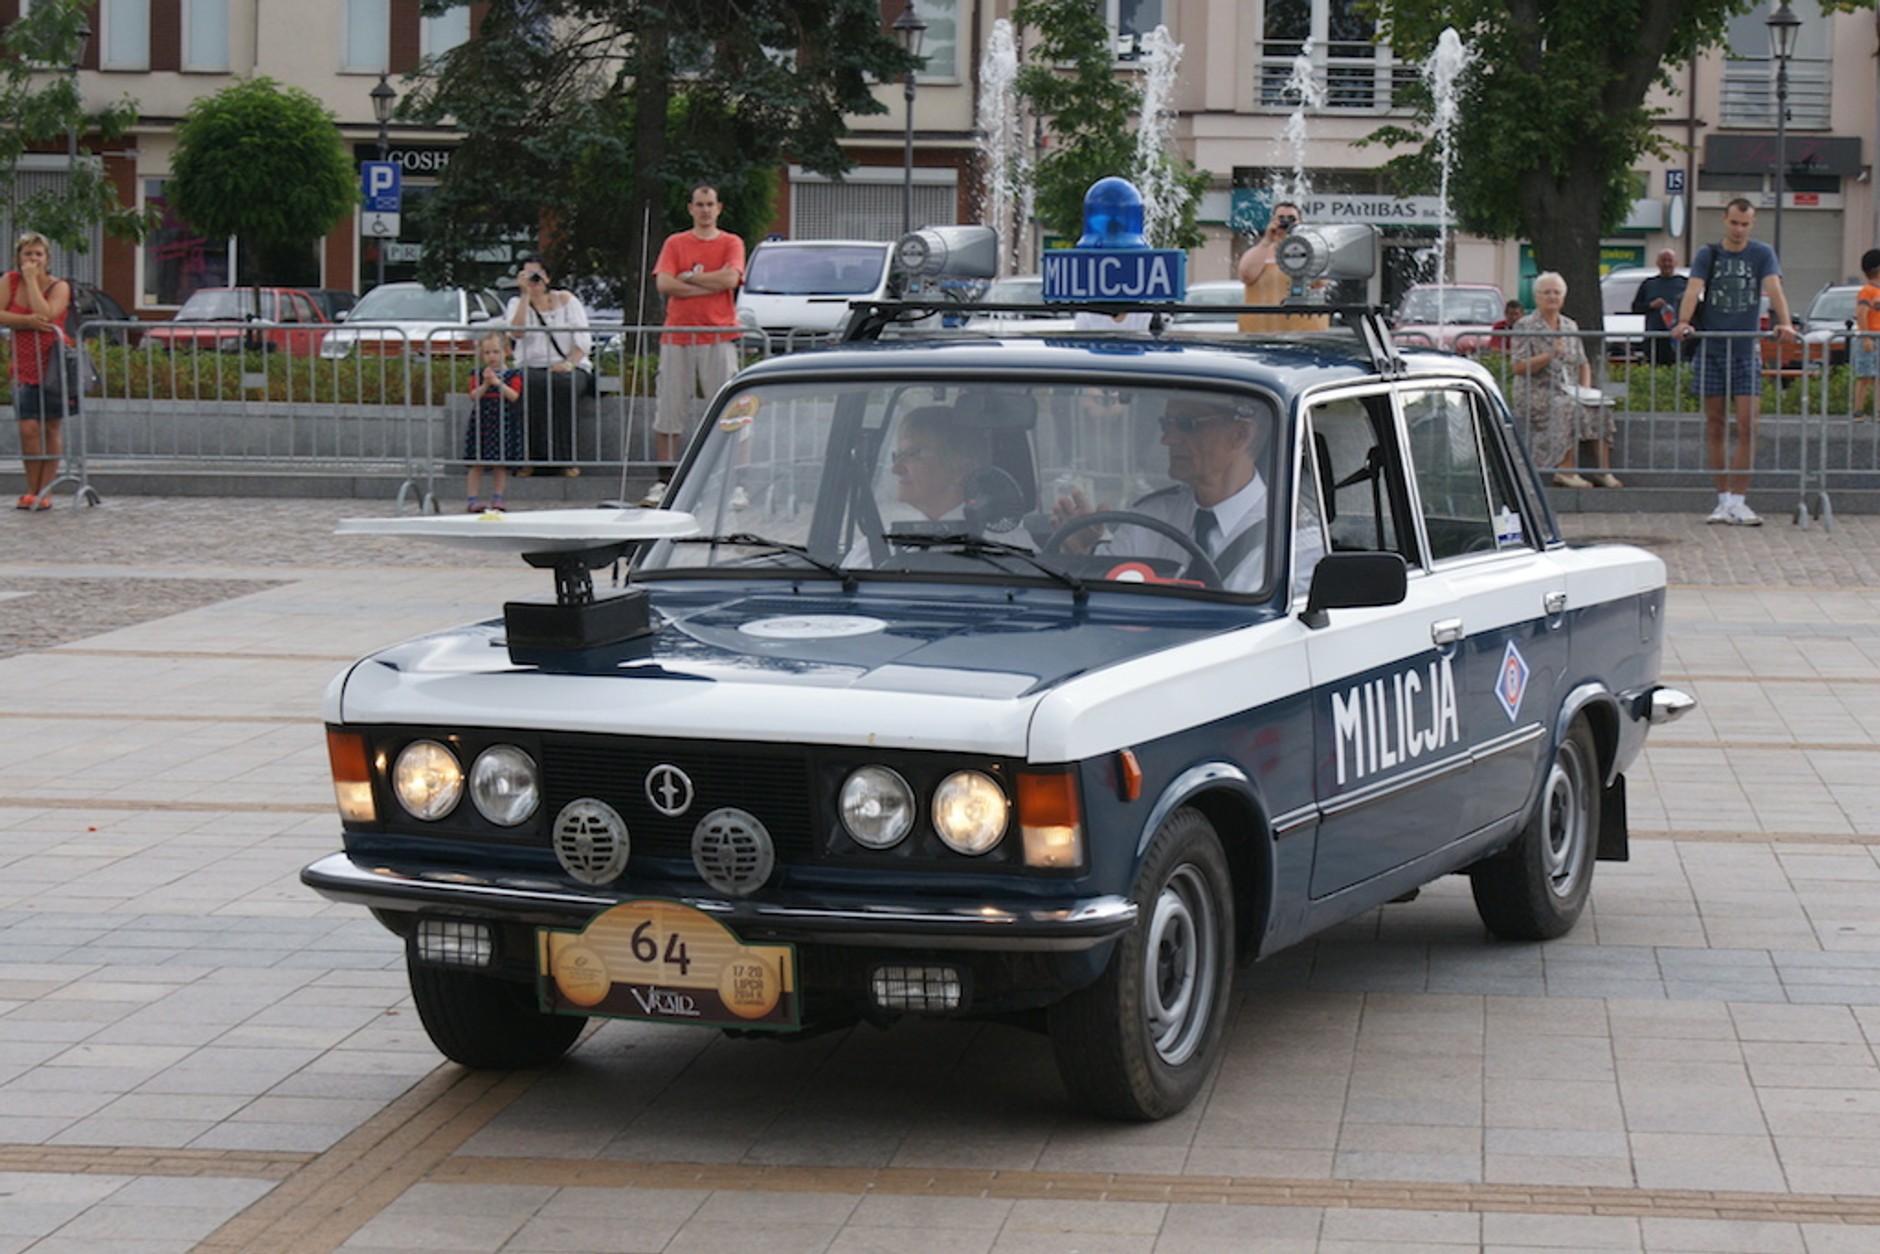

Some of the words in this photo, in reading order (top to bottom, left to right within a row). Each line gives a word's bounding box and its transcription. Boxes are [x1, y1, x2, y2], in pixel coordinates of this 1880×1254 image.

[387, 151, 450, 170] GOSH
[370, 166, 394, 197] P
[1668, 172, 1683, 188] 15
[1300, 202, 1325, 216] NP
[1331, 202, 1417, 217] PARIBAS
[1044, 256, 1172, 297] MILICJA
[1331, 656, 1460, 785] MILICJA
[631, 920, 691, 975] 64
